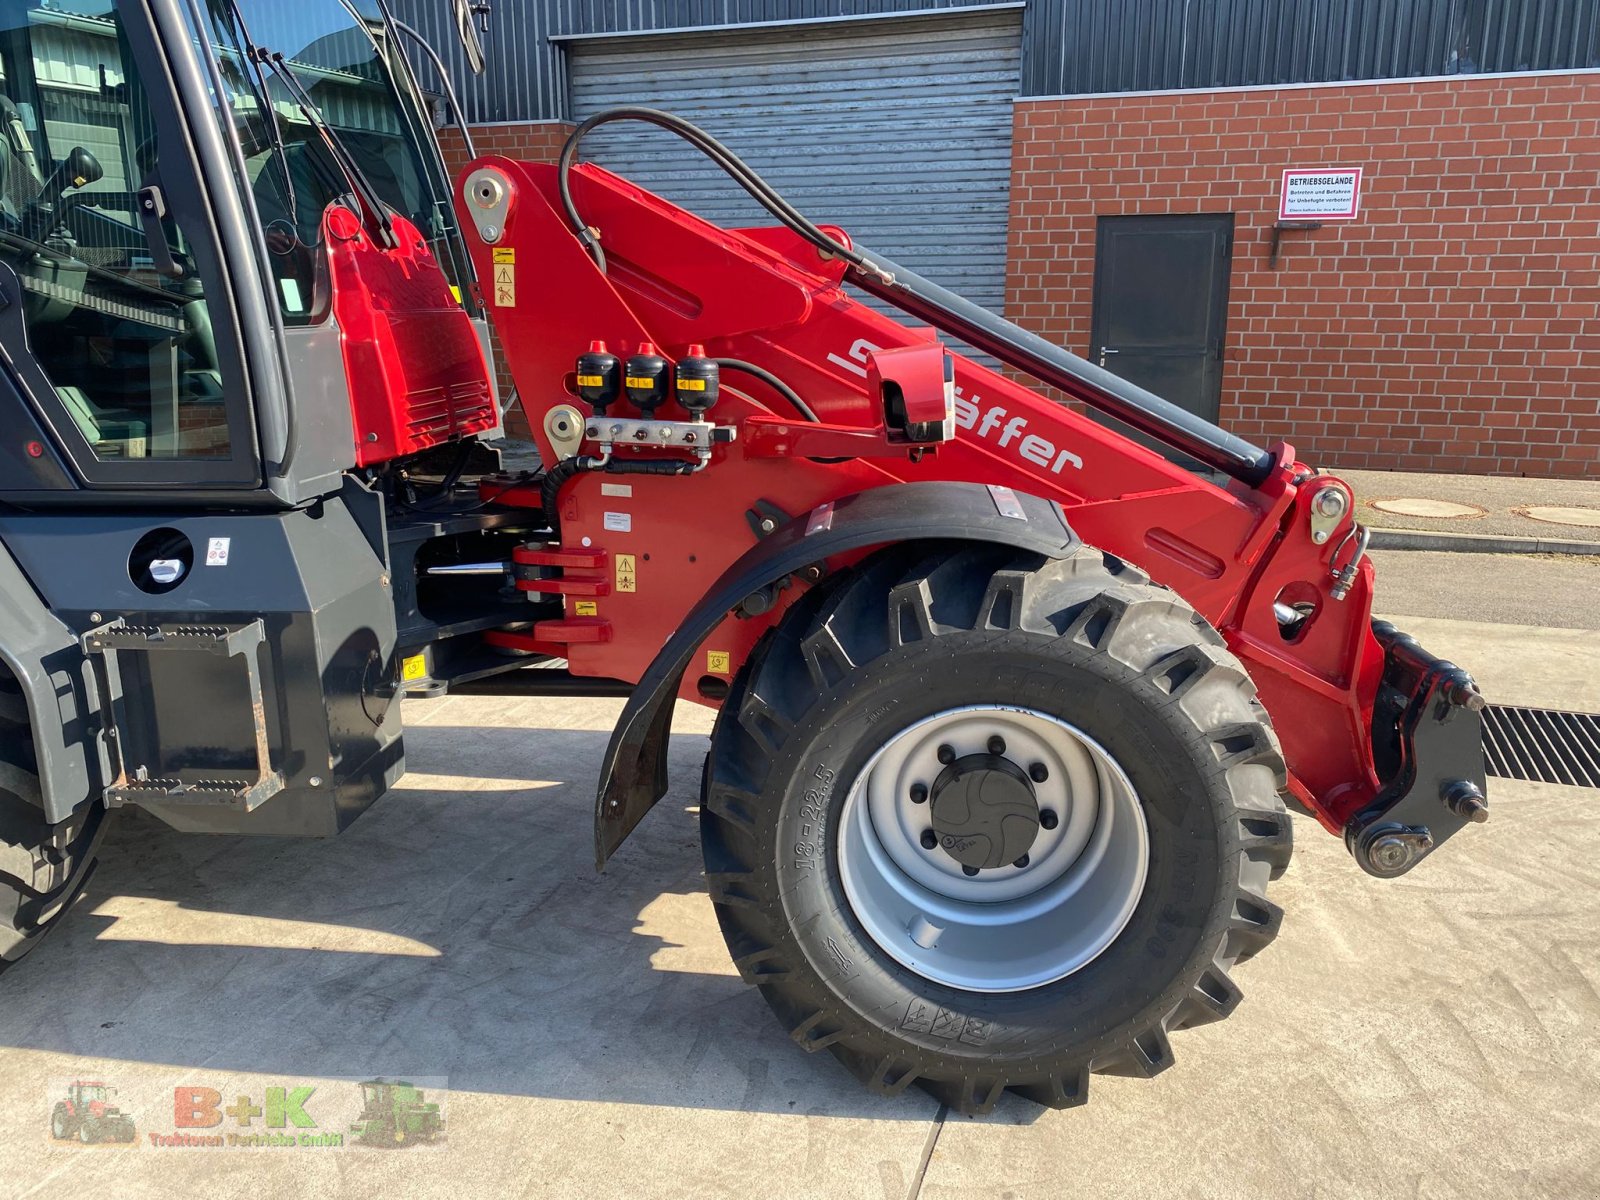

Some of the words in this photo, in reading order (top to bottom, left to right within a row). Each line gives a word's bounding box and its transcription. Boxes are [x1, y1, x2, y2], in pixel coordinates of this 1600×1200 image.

[1290, 176, 1353, 186] BETRIEBSGELÄNDE
[826, 338, 1083, 475] Säffer
[795, 763, 835, 870] 18-22.5
